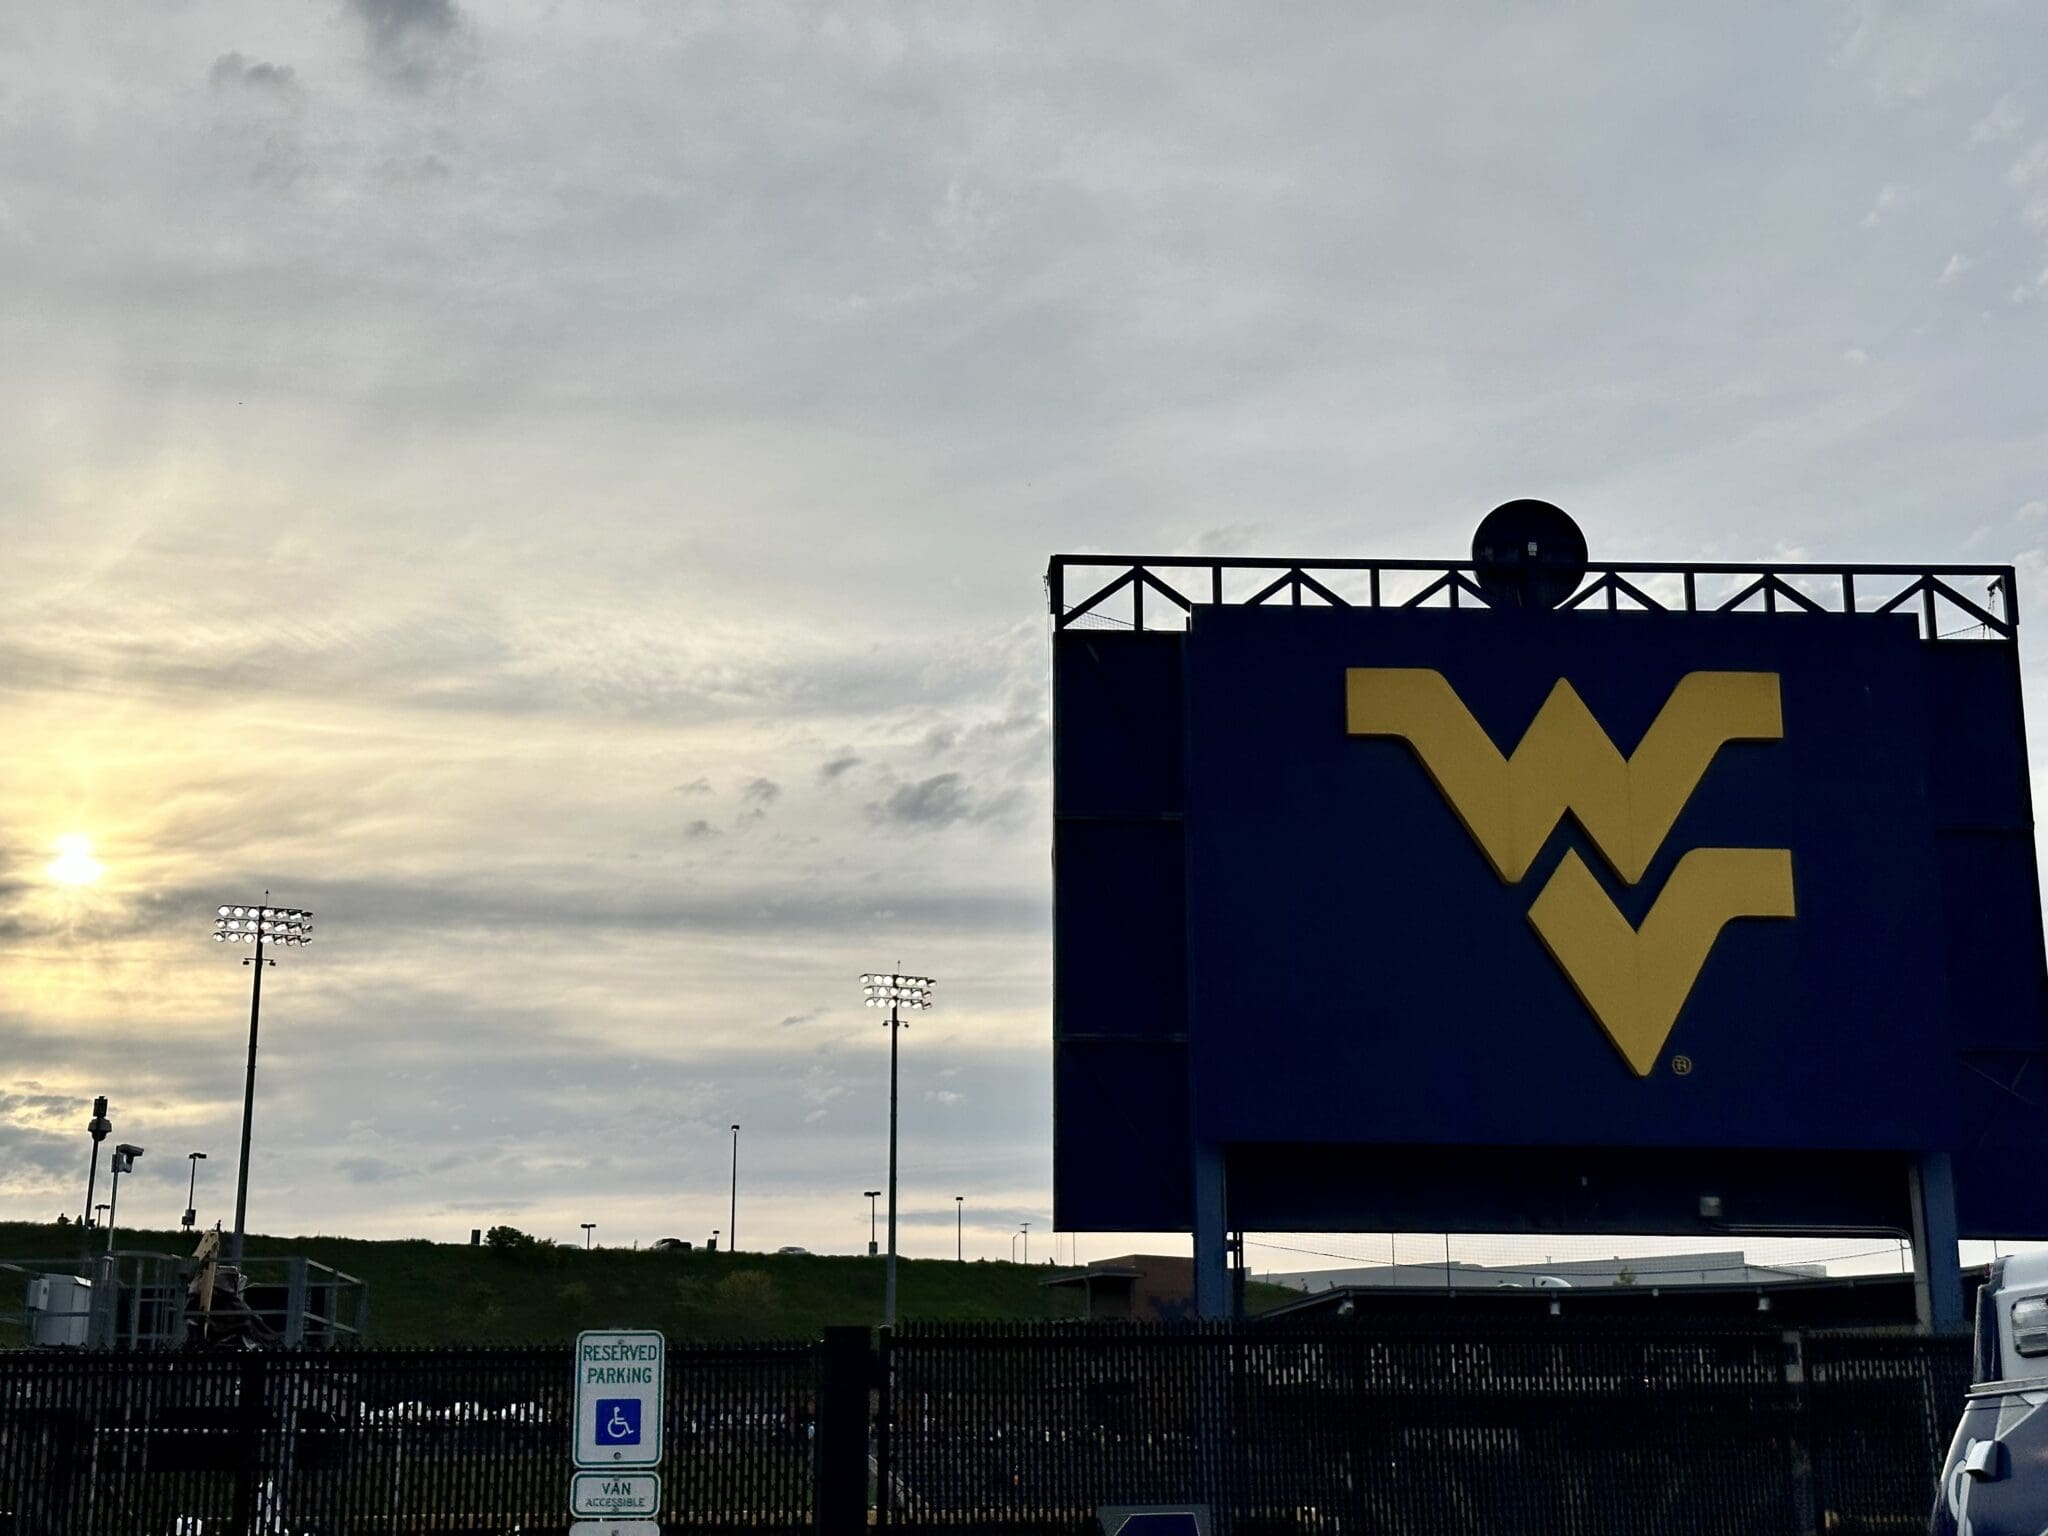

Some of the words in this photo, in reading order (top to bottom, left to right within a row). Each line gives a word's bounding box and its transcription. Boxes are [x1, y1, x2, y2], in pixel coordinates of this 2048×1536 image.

[583, 1345, 658, 1361] RESERVED
[587, 1367, 652, 1384] PARKING
[602, 1482, 631, 1496] VAN
[585, 1497, 646, 1508] ACCESSIBLE
